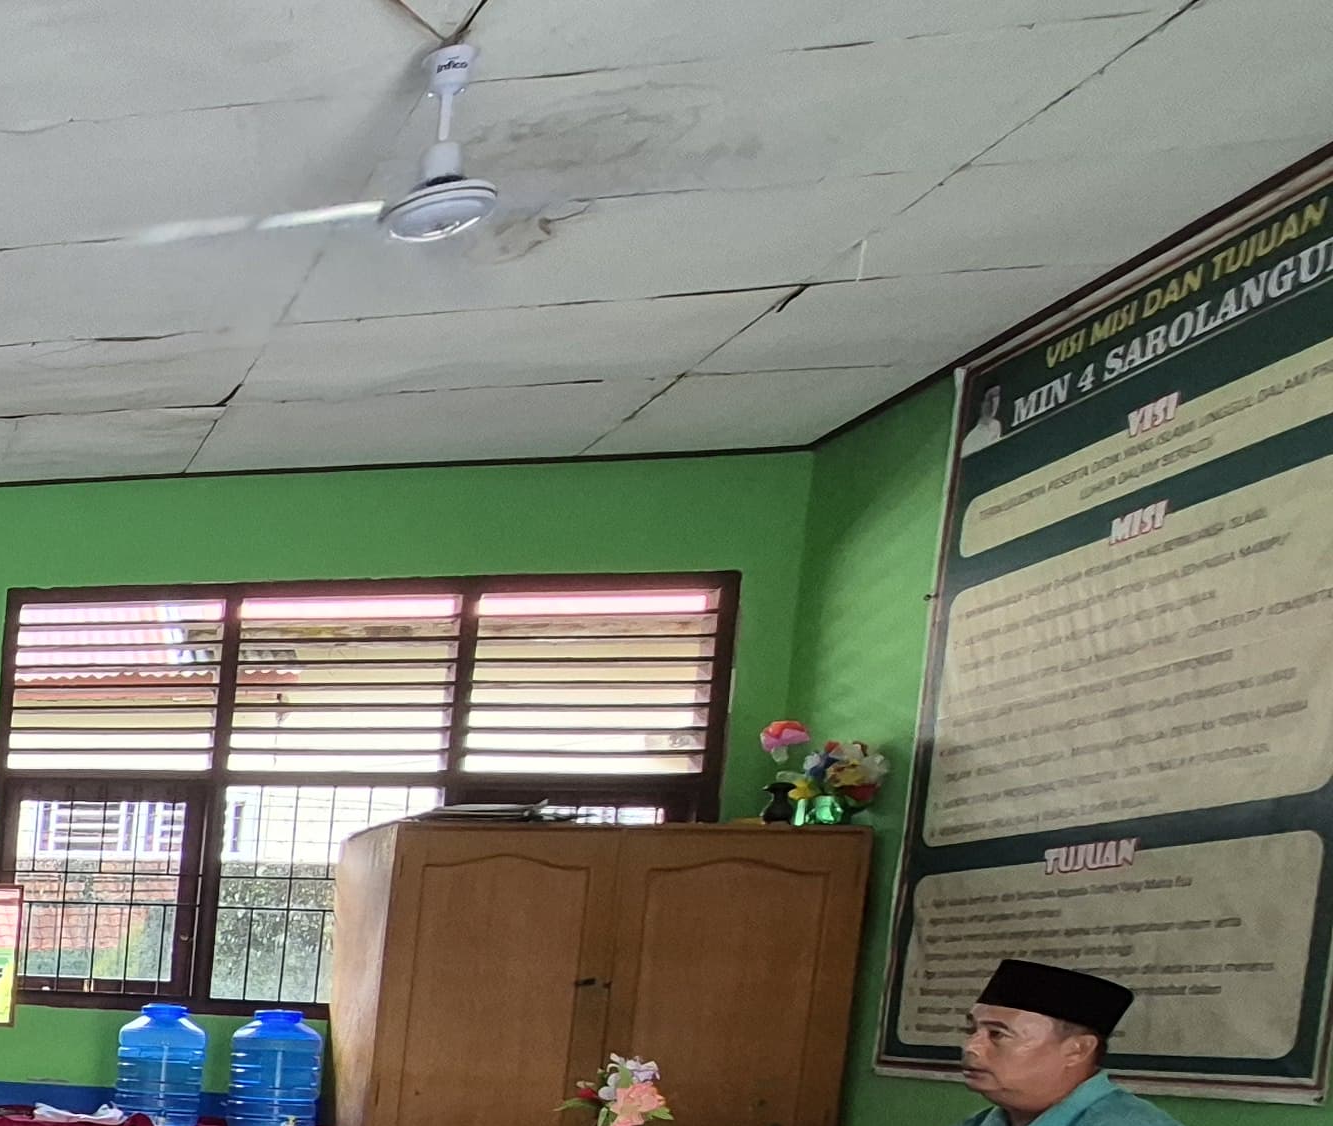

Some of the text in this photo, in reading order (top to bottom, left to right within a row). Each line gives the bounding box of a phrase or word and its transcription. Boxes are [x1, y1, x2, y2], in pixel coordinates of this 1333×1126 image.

[1046, 196, 1328, 368] VISI MISI DAN TUJUAN
[1012, 236, 1333, 428] MIN 4 SAROLANGU
[1127, 391, 1181, 438] VISI
[1109, 499, 1169, 546] MISI
[1045, 838, 1140, 875] TUJUAN
